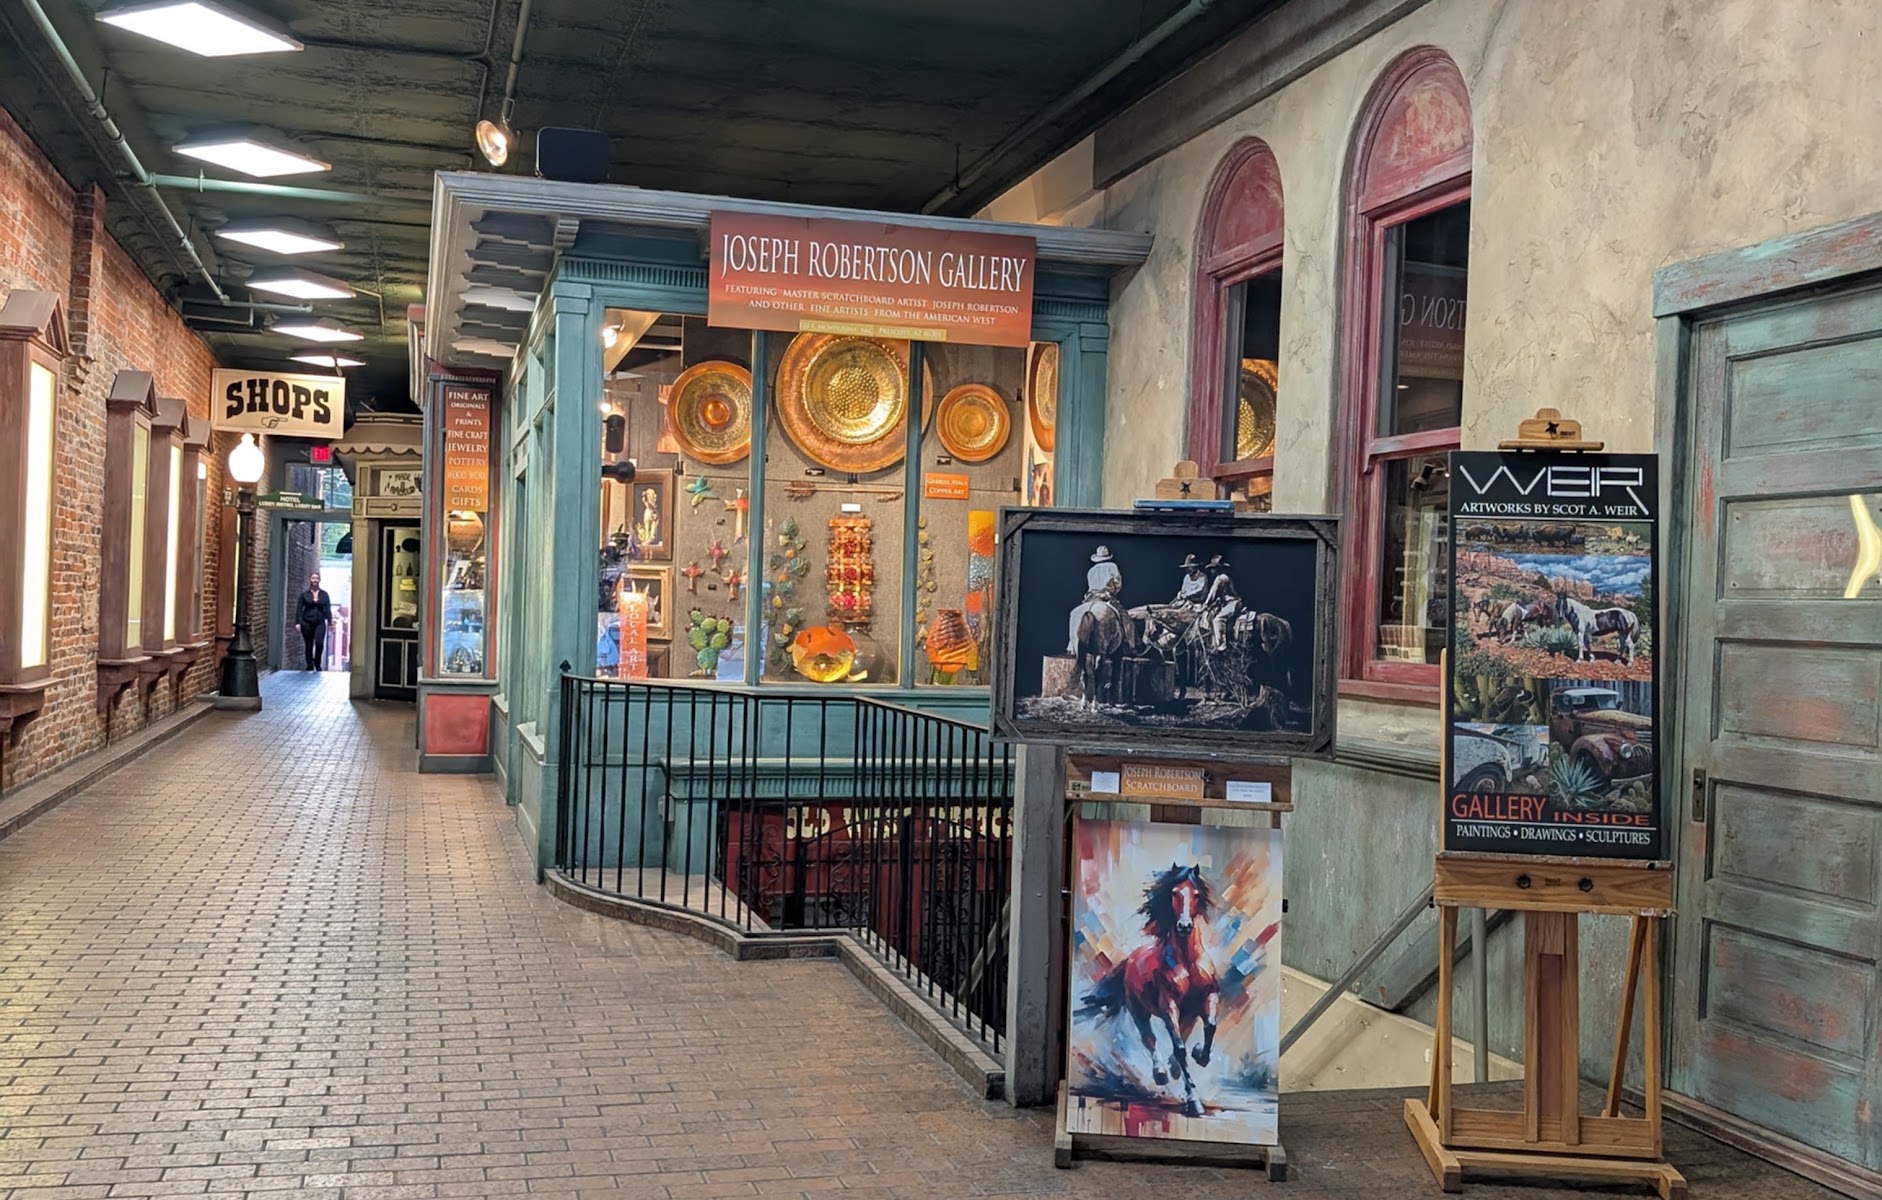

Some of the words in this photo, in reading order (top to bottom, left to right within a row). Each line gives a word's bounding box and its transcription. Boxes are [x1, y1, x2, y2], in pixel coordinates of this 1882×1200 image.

[720, 234, 799, 279] JOSEPH
[808, 241, 933, 285] ROBERTSON
[938, 252, 1027, 292] GALLERY
[725, 284, 778, 297] FEATURING
[783, 289, 820, 300] MASTER
[821, 290, 895, 306] SCRATCHBOARD
[896, 298, 928, 308] ARTIST
[932, 300, 965, 311] JOSEPH
[967, 303, 1019, 314] ROBERTSON
[749, 299, 771, 310] AND
[772, 301, 805, 312] OTHER
[810, 304, 831, 314] FINE
[833, 306, 869, 317] ARTISTS
[874, 308, 901, 318] FROM
[903, 311, 921, 320] THE
[923, 313, 970, 324] AMERICAN
[972, 316, 996, 325] WEST
[226, 378, 331, 425] SHOPS
[449, 391, 469, 400] FINE
[472, 393, 488, 401] ART
[455, 418, 482, 426] PRINTS
[448, 430, 464, 439] FINE
[465, 431, 488, 440] CRAFT
[447, 443, 488, 453] JEWELRY
[449, 457, 487, 466] POTTERY
[452, 485, 482, 494] CARDS
[1459, 465, 1649, 515] WEIR
[452, 497, 481, 507] GIFTS
[1460, 502, 1531, 514] ARTWORKS
[1534, 504, 1550, 514] BY
[1552, 504, 1586, 515] SCOT
[1588, 505, 1602, 516] A.
[1605, 505, 1638, 516] WEIR
[1124, 765, 1153, 779] JOSEPH
[1154, 767, 1202, 781] ROBERTSON
[1126, 780, 1199, 793] SCRATCHBOARD
[1452, 794, 1546, 822] GALLERY
[1554, 811, 1650, 826] INSIDE
[1456, 824, 1511, 839] PAINTINGS
[1520, 827, 1576, 842] DRAWINGS
[1586, 830, 1650, 845] SCULPTURES
